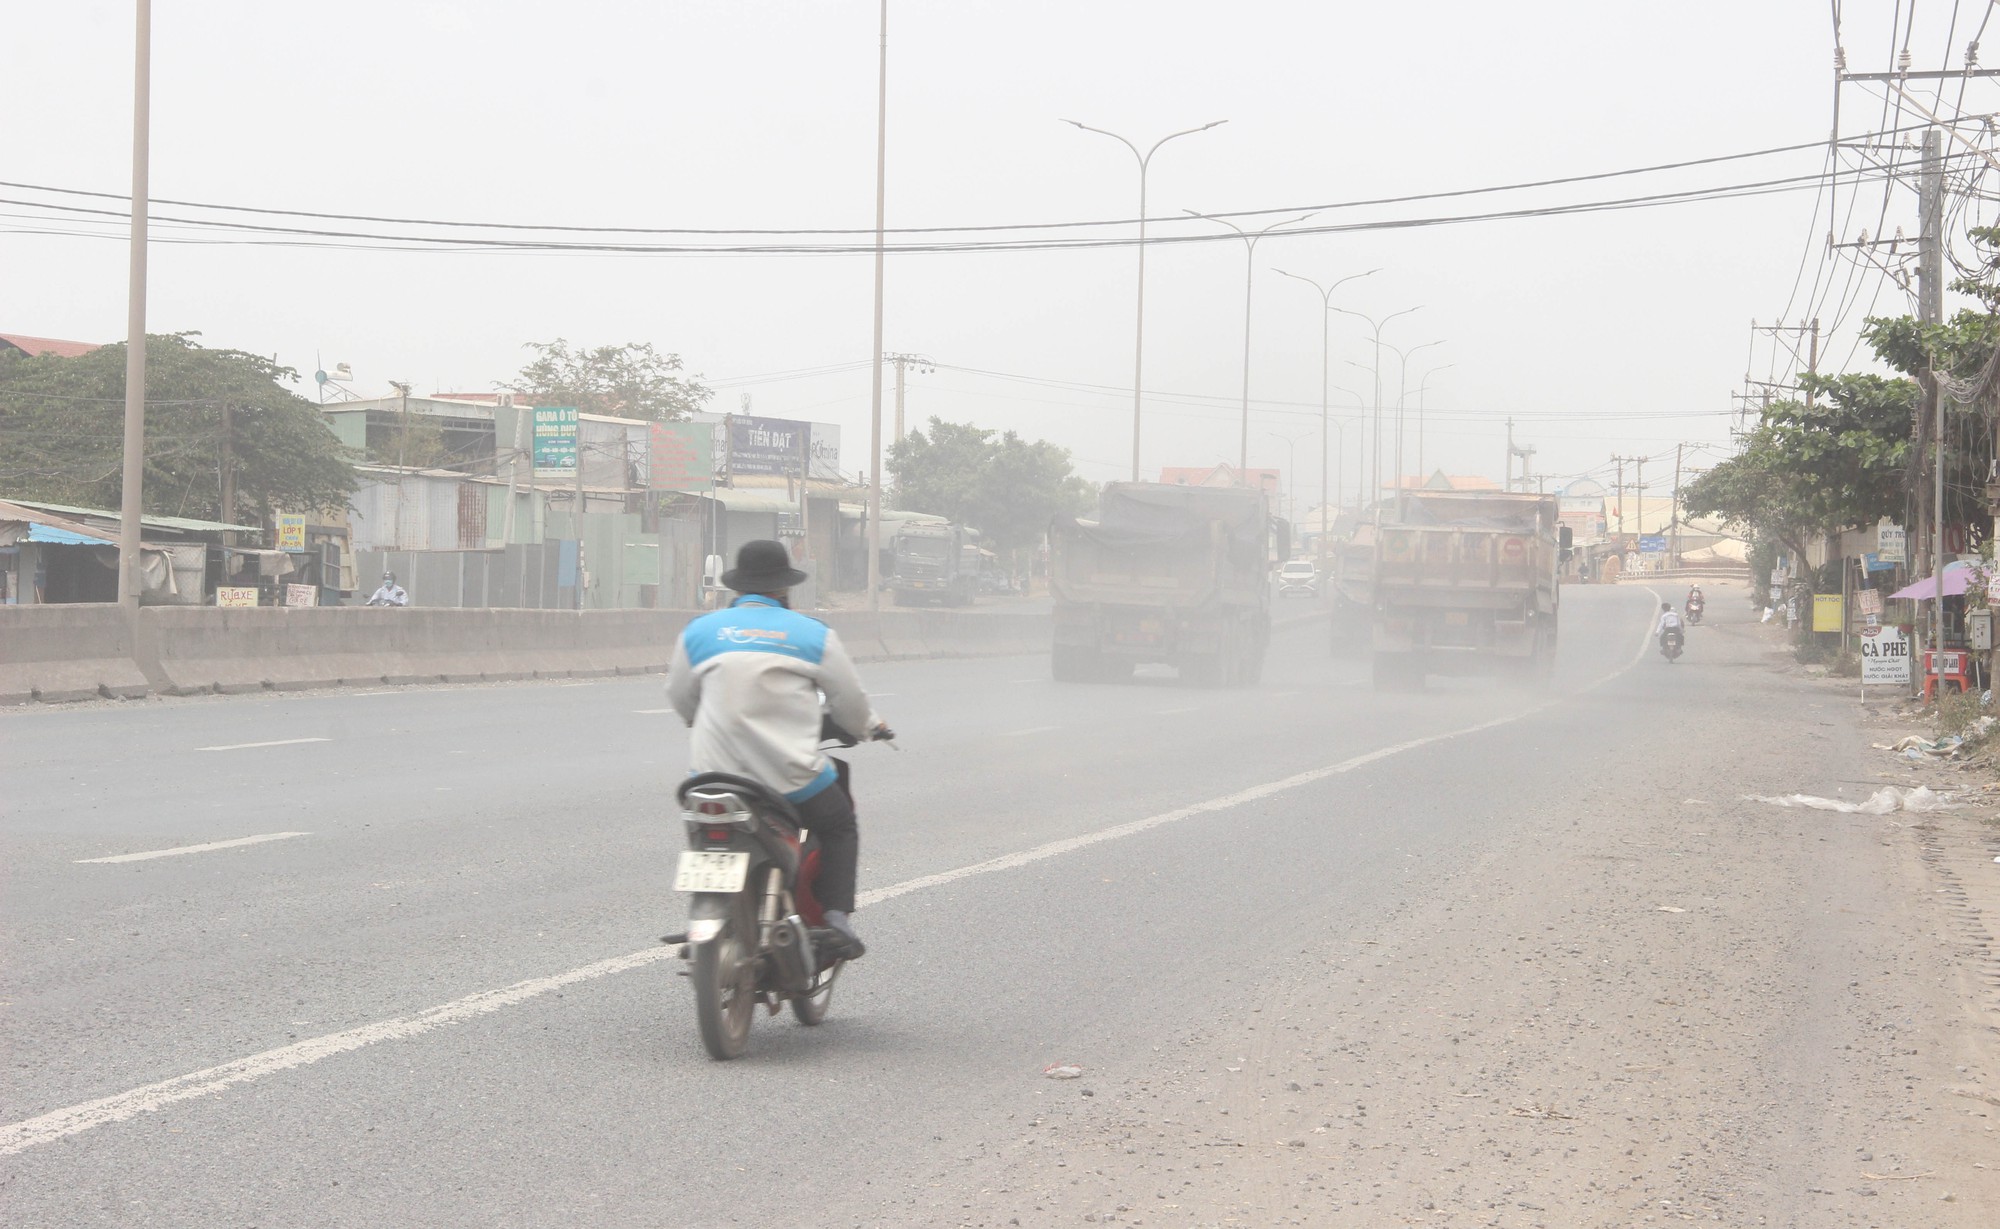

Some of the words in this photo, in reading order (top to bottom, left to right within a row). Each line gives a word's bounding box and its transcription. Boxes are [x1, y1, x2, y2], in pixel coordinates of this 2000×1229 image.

[536, 411, 557, 422] GARA
[559, 409, 565, 421] Ô
[567, 409, 578, 421] TÔ
[536, 423, 558, 437] HÙNG
[560, 424, 577, 437] DUY
[748, 423, 770, 447] TIẾN
[1862, 638, 1879, 657] CÀ
[1882, 638, 1908, 657] PHÊ
